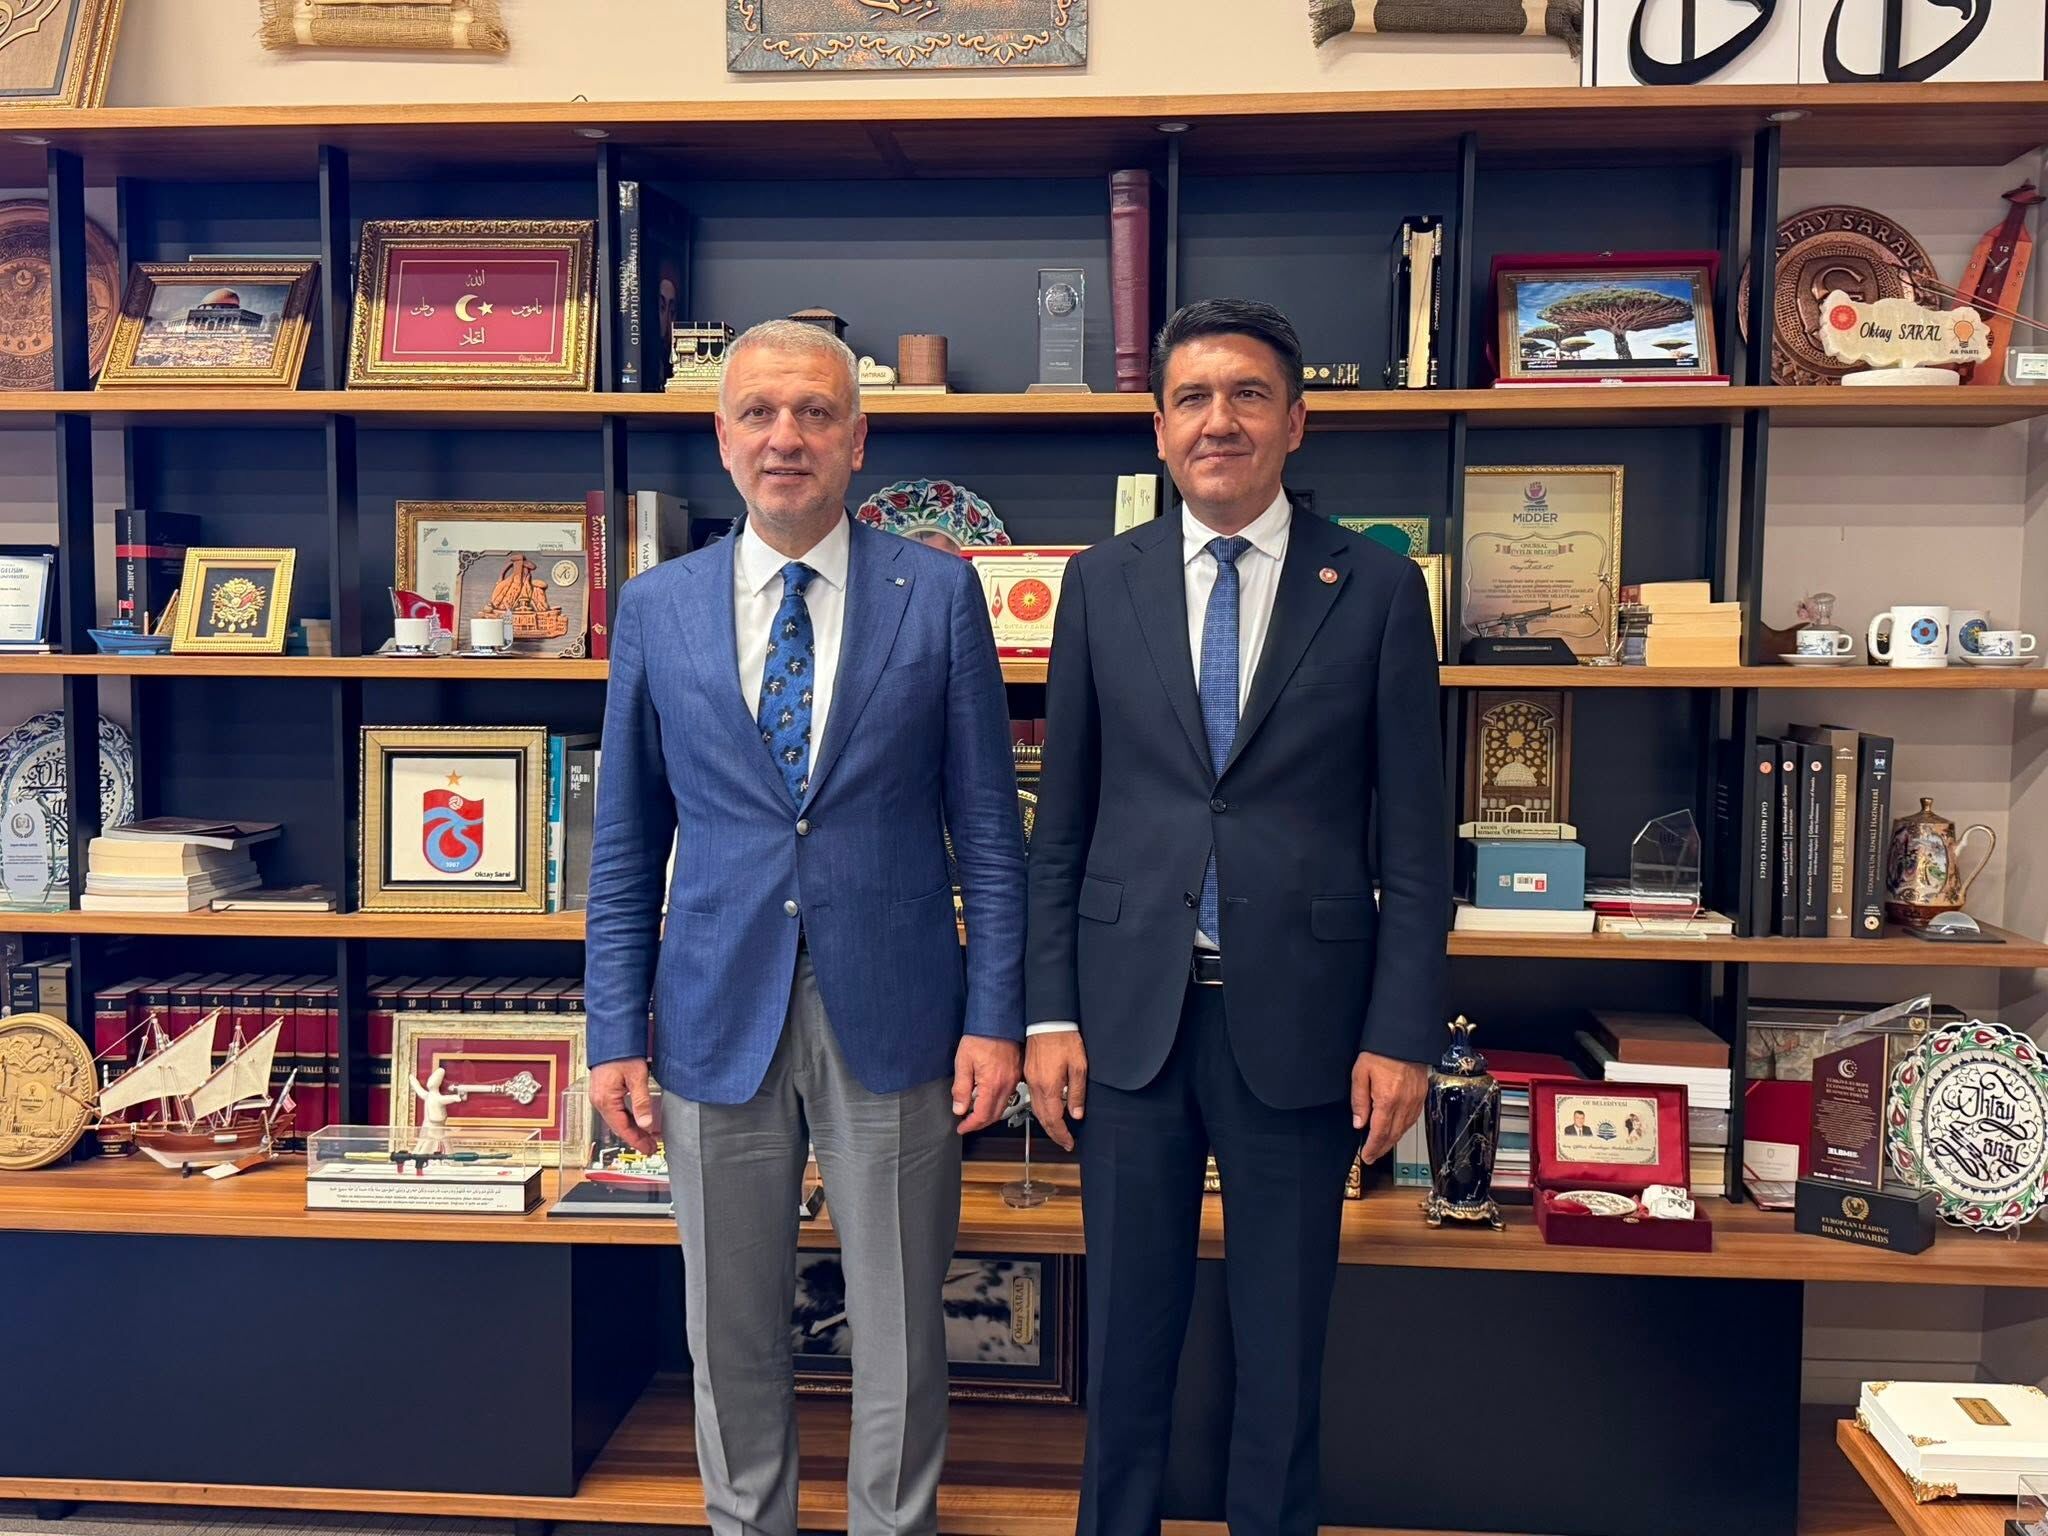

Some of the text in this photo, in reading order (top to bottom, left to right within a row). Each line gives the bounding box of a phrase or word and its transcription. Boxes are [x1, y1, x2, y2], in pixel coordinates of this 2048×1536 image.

[2000, 245, 2009, 253] 12
[1860, 321, 1942, 342] Oktay SARAL
[1834, 774, 1847, 806] OSMANLI
[107, 1000, 112, 1010] 1
[181, 996, 186, 1005] 3
[212, 996, 218, 1005] 4
[243, 997, 248, 1006] 5
[275, 997, 280, 1006] 6
[308, 998, 313, 1007] 7
[408, 999, 417, 1008] 10
[441, 1000, 449, 1008] 11
[473, 1001, 481, 1009] 12
[505, 1000, 513, 1009] 13
[537, 1001, 546, 1009] 14
[569, 1001, 577, 1010] 15
[1821, 1216, 1889, 1235] EUROPEAN LEADING
[1821, 1224, 1889, 1244] BRAND AWARDS
